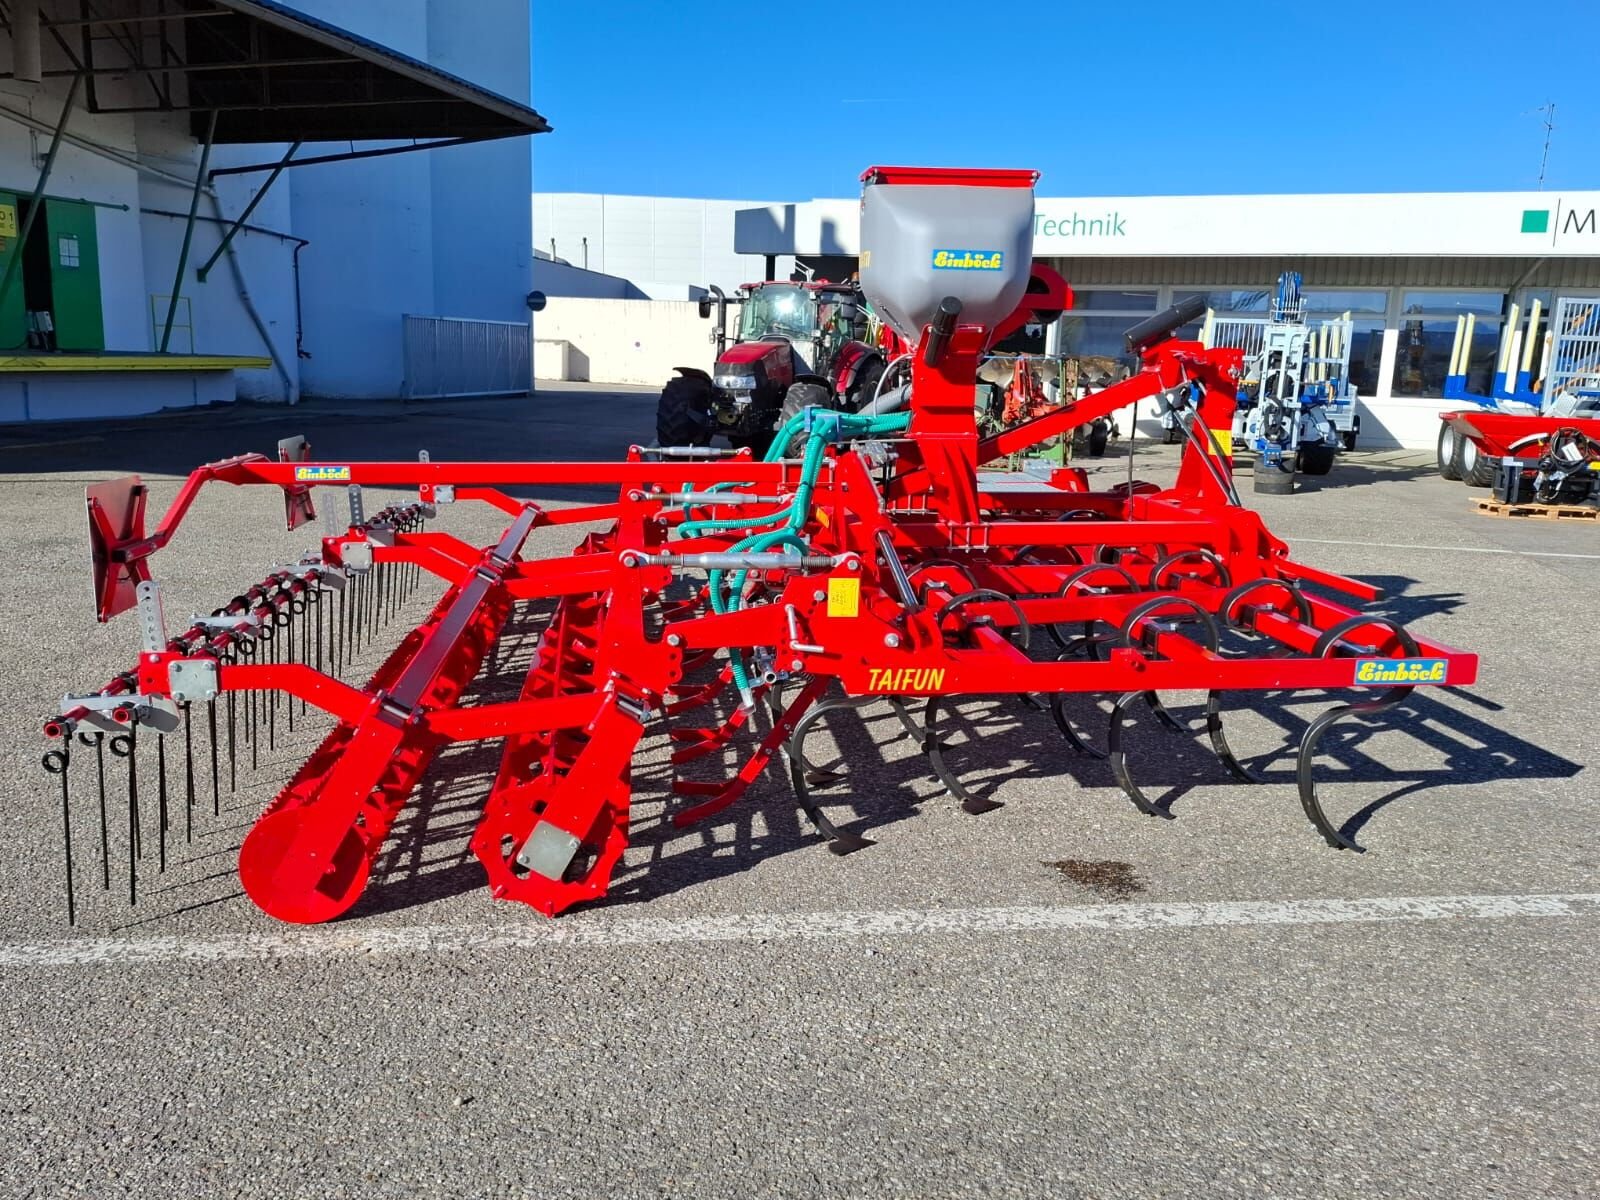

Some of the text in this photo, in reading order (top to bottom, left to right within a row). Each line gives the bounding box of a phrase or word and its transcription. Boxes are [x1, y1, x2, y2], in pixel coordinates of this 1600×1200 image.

[1034, 212, 1127, 237] Technik
[1563, 208, 1596, 234] M
[934, 250, 1002, 270] Einböck
[868, 667, 945, 692] TAIFUN
[1357, 661, 1446, 682] Einböck
